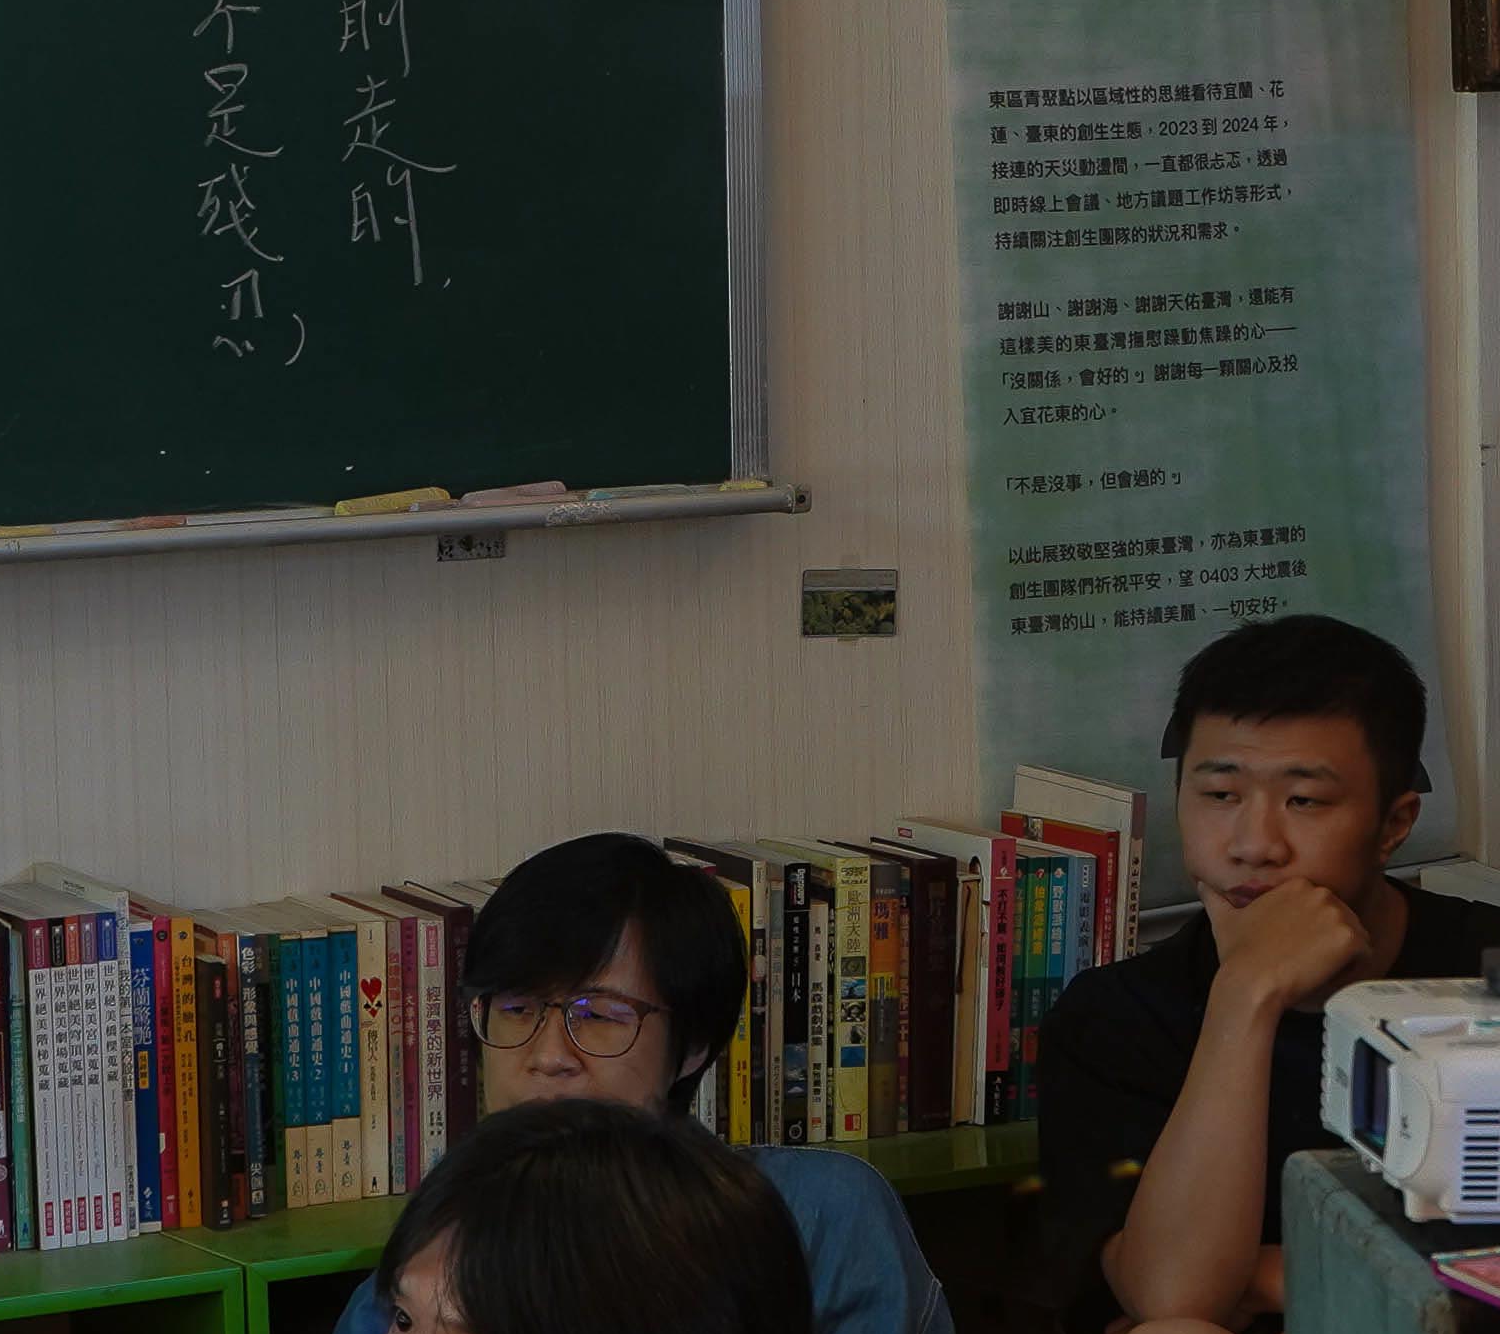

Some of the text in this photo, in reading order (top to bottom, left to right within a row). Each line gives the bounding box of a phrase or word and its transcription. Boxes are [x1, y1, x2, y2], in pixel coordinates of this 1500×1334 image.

[1201, 117, 1219, 136] 到
[1222, 117, 1260, 134] 2024
[1002, 403, 1119, 426] 入宜花東的心。
[1199, 566, 1240, 585] 0403
[1243, 558, 1308, 582] 大地震後
[33, 969, 51, 1092] 世界絕美階梯蒐藏
[53, 968, 70, 1089] 世界絕美劇場蒐藏
[83, 966, 100, 1086] 世界絕美宮殿蒐藏
[425, 984, 443, 1100] 經濟學的新世界
